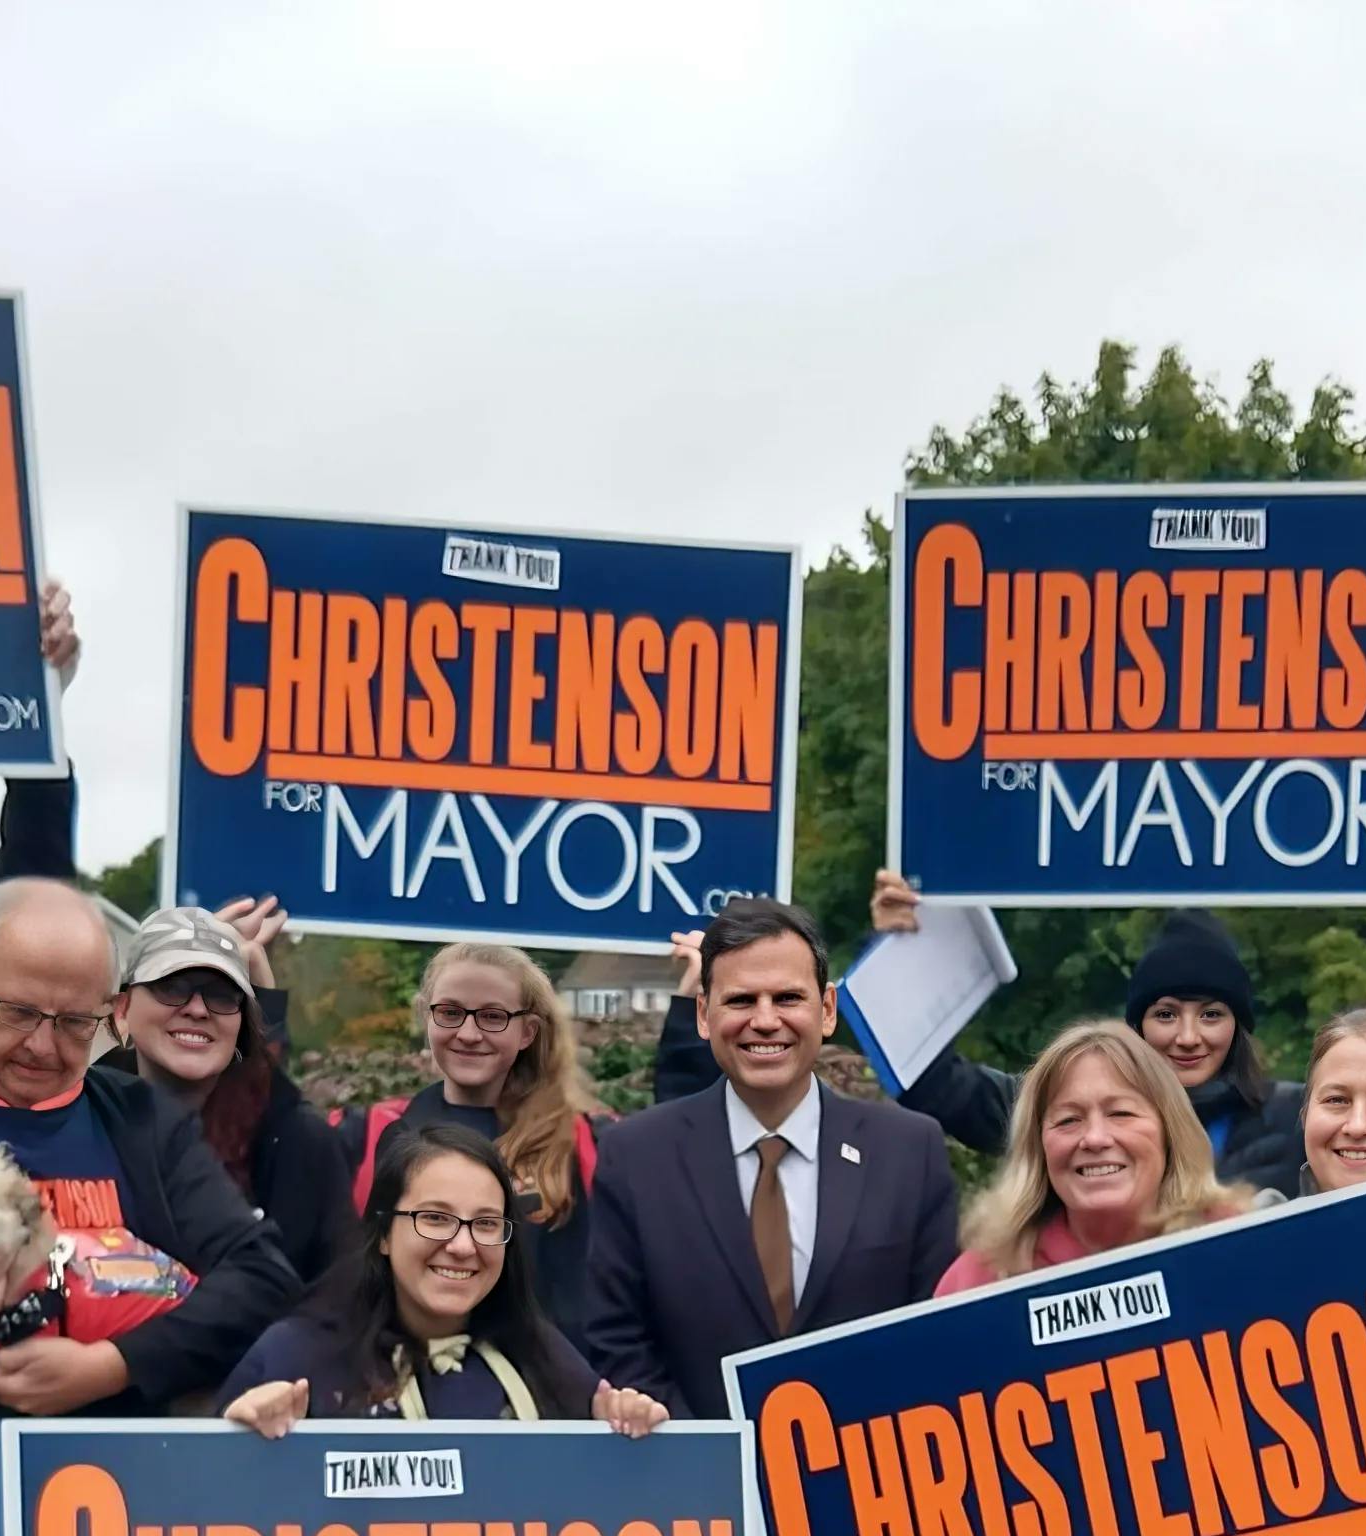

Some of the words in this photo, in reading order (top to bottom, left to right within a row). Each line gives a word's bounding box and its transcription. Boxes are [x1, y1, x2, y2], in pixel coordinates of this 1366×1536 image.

[1154, 512, 1213, 544] THANK
[449, 543, 509, 574] THANK
[191, 537, 778, 783] CHRISTENSON
[981, 761, 1036, 790] FOR
[264, 780, 322, 813] FOR
[1035, 1286, 1106, 1339] THANK
[1105, 1280, 1164, 1320] YOU!
[327, 1455, 400, 1494] THANK
[408, 1453, 456, 1491] YOU!
